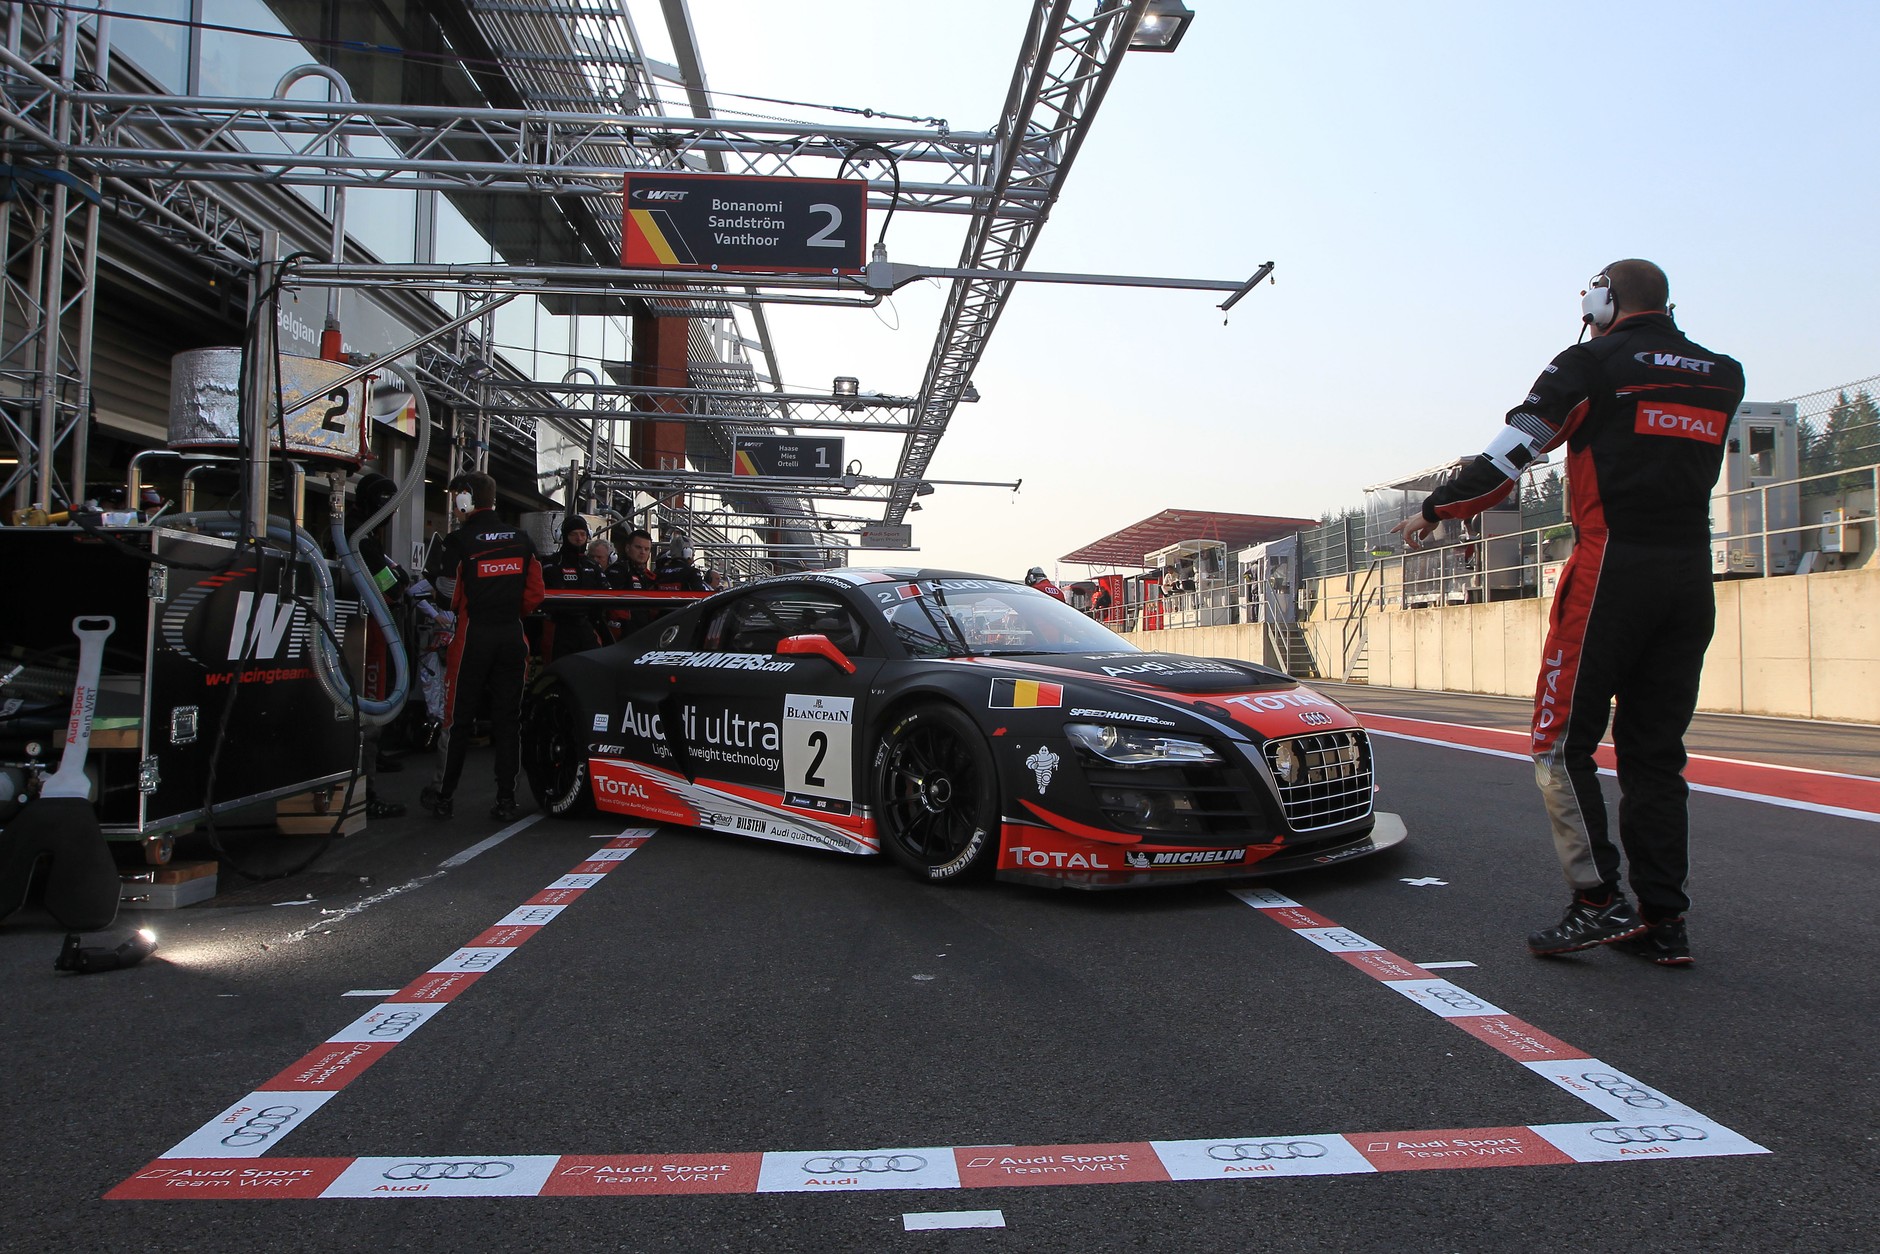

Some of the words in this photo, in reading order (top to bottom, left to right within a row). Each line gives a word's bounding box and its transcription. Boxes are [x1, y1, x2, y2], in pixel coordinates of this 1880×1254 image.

[646, 190, 689, 201] WRT
[712, 198, 783, 213] Bonanomi
[708, 215, 785, 230] Sandström
[806, 203, 846, 248] 2
[714, 232, 780, 247] Vanthoor
[1653, 352, 1715, 374] WRT
[321, 386, 350, 434] 2
[1642, 409, 1718, 437] TOTAL
[815, 447, 830, 468] 1
[485, 531, 516, 541] WRT
[480, 563, 521, 573] TOTAL
[815, 575, 852, 590] Vanthoor
[926, 579, 989, 592] Audi
[877, 592, 895, 604] 2
[1101, 661, 1175, 677] Audi
[71, 685, 86, 716] Sport
[84, 687, 97, 713] WRT
[1533, 649, 1563, 746] TOTAL
[786, 706, 849, 722] BLANCPAIN
[705, 708, 780, 751] ultra
[597, 744, 625, 755] WRT
[722, 750, 780, 772] technology
[804, 730, 828, 788] 2
[593, 775, 650, 799] TOTAL
[736, 816, 767, 834] BILSTEIN
[770, 826, 790, 838] Audi
[790, 830, 821, 844] quattro
[823, 835, 851, 848] GmbH
[930, 843, 977, 879] MICHELIN
[1008, 846, 1109, 869] TOTAL
[1152, 849, 1247, 864] MICHELIN
[1521, 1033, 1556, 1054] Sport
[340, 1050, 363, 1065] Audi
[311, 1064, 345, 1085] Sport
[1554, 1073, 1591, 1092] Audi
[221, 1106, 252, 1124] Audi
[1397, 1139, 1449, 1149] Audi
[1452, 1137, 1521, 1147] Sport
[1401, 1149, 1468, 1159] Team
[1473, 1146, 1524, 1156] WRT
[1619, 1146, 1670, 1156] Audi
[999, 1155, 1055, 1165] Audi
[1061, 1154, 1130, 1163] Sport
[173, 1168, 236, 1177] Audi
[239, 1168, 314, 1178] Sport
[594, 1164, 654, 1174] Audi
[660, 1164, 732, 1174] Sport
[1001, 1164, 1067, 1174] Team
[1071, 1162, 1130, 1172] WRT
[1223, 1164, 1276, 1173] Audi
[165, 1179, 231, 1187] Team
[239, 1178, 301, 1187] WRT
[593, 1174, 658, 1184] Team
[665, 1173, 725, 1182] WRT
[804, 1178, 859, 1186] Audi
[371, 1183, 430, 1192] Audi
